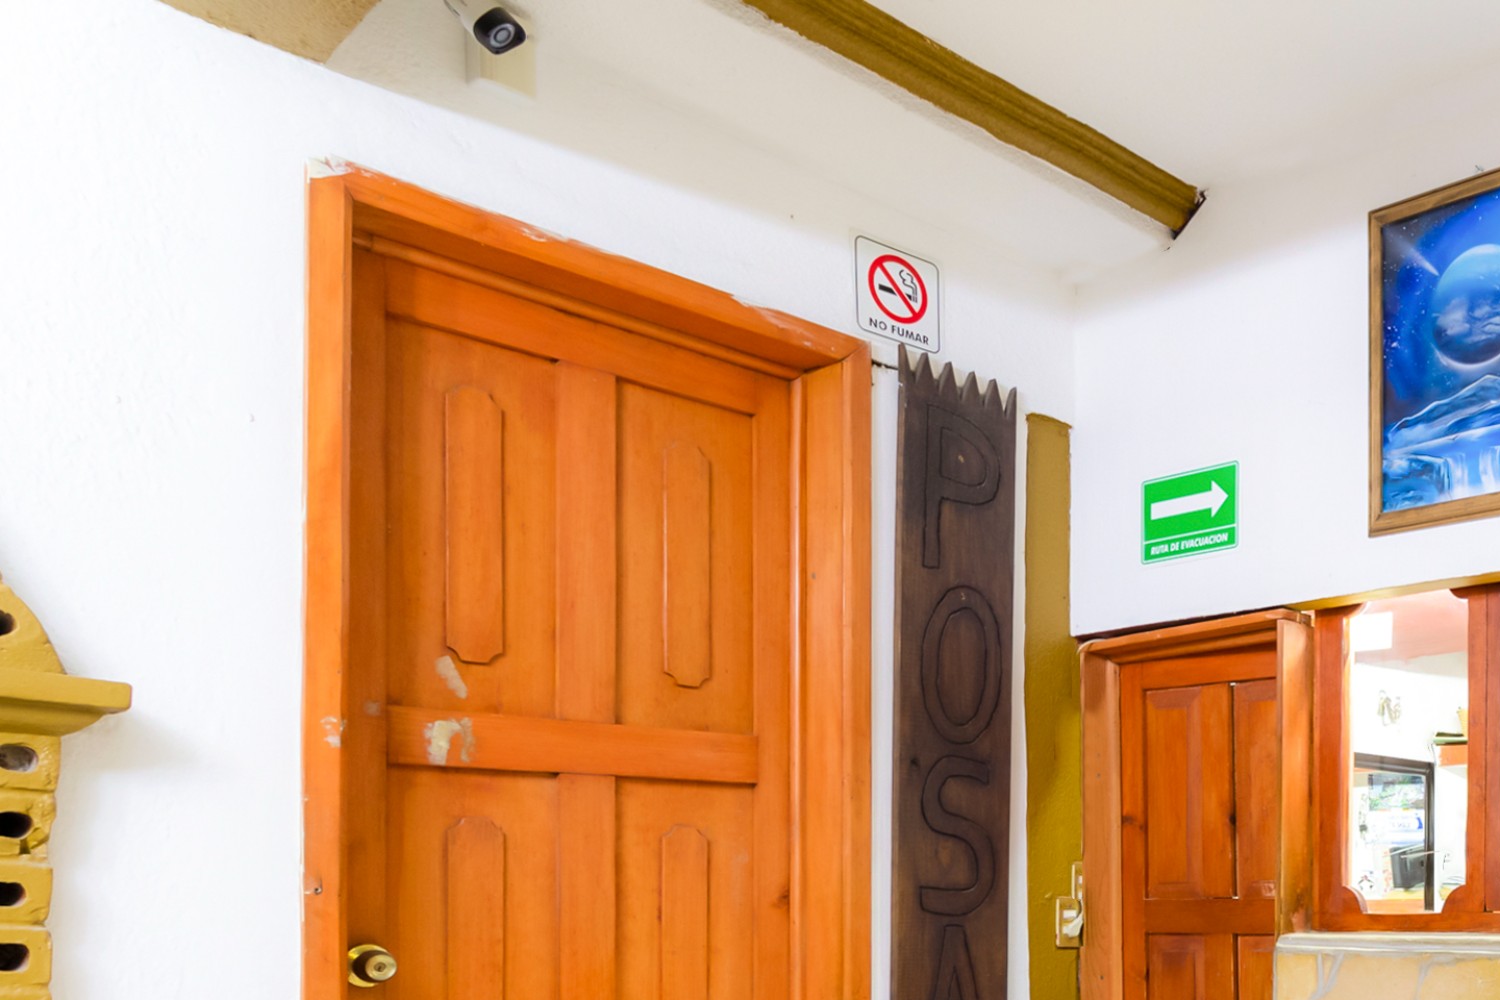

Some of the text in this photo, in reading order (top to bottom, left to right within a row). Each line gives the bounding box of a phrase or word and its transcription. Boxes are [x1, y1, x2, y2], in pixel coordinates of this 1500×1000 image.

[869, 317, 929, 345] NO FUMAR
[1150, 532, 1229, 556] RUTA DE EVACUACION
